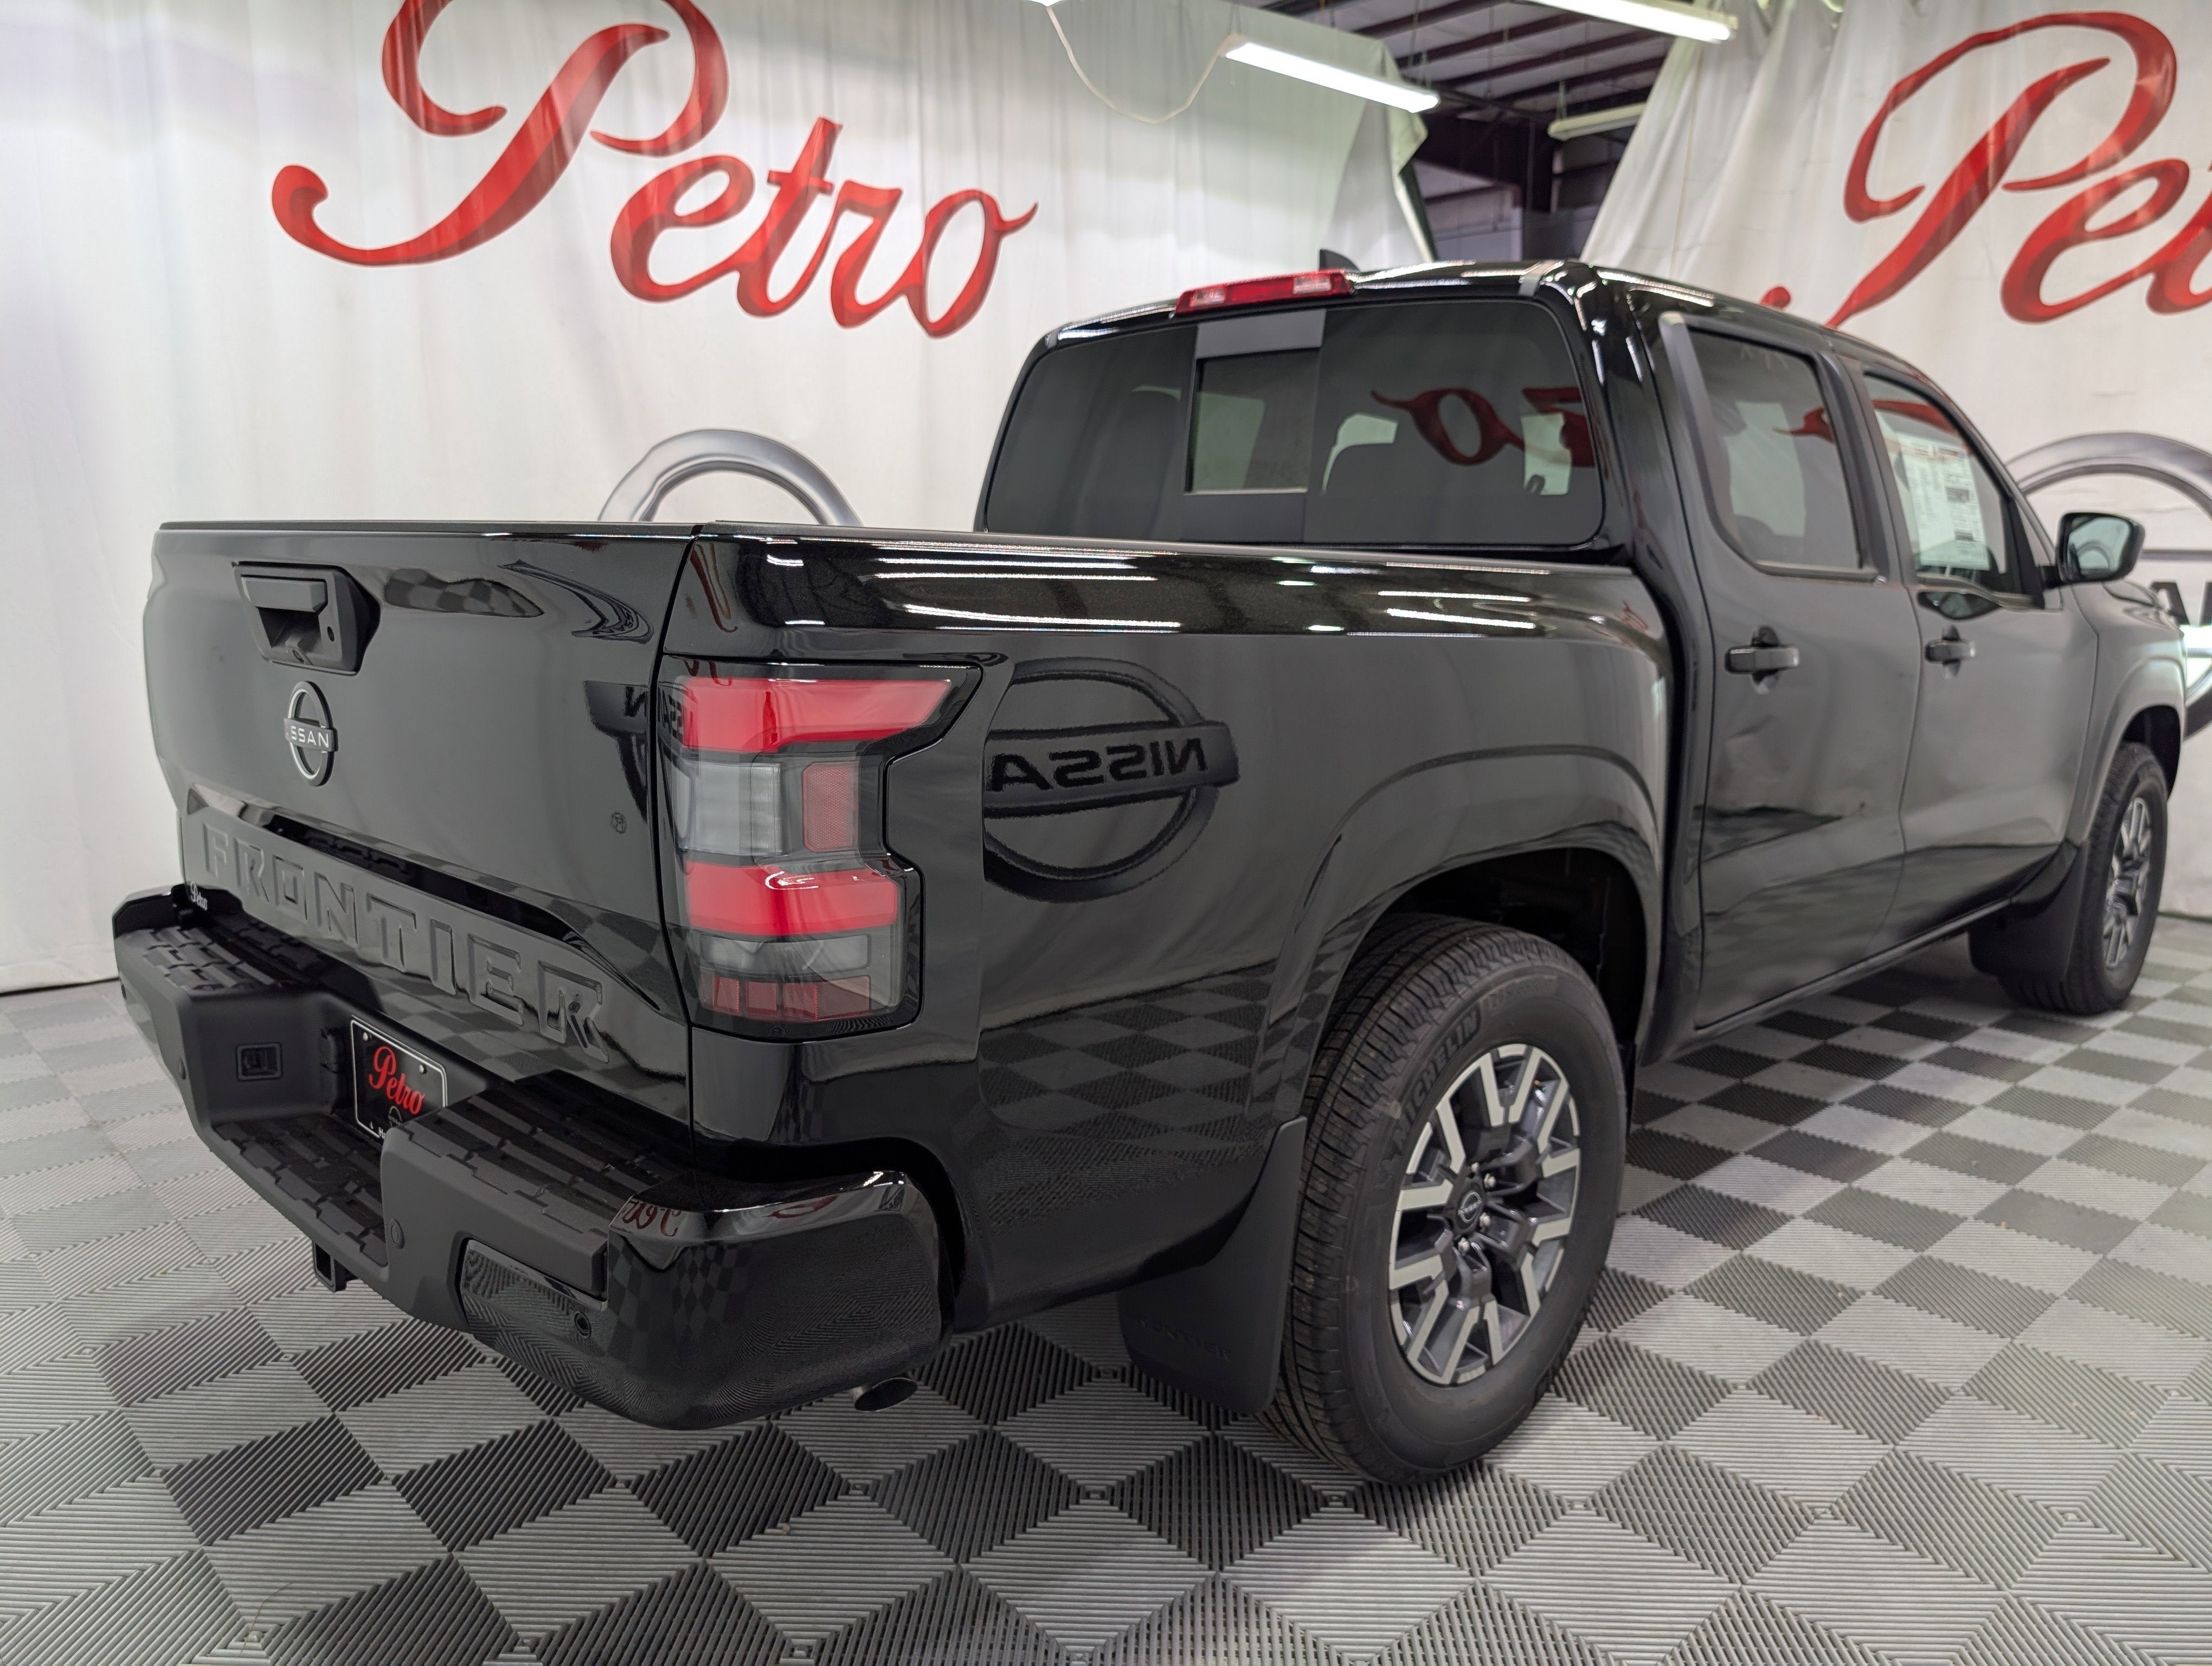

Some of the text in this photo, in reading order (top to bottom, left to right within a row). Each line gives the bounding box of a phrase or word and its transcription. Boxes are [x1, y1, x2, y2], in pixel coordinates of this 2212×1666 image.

[272, 0, 1039, 339] Petro
[204, 822, 609, 1062] FRONTIER
[368, 1046, 425, 1115] Petro
[1389, 1009, 1480, 1151] MICHELIN
